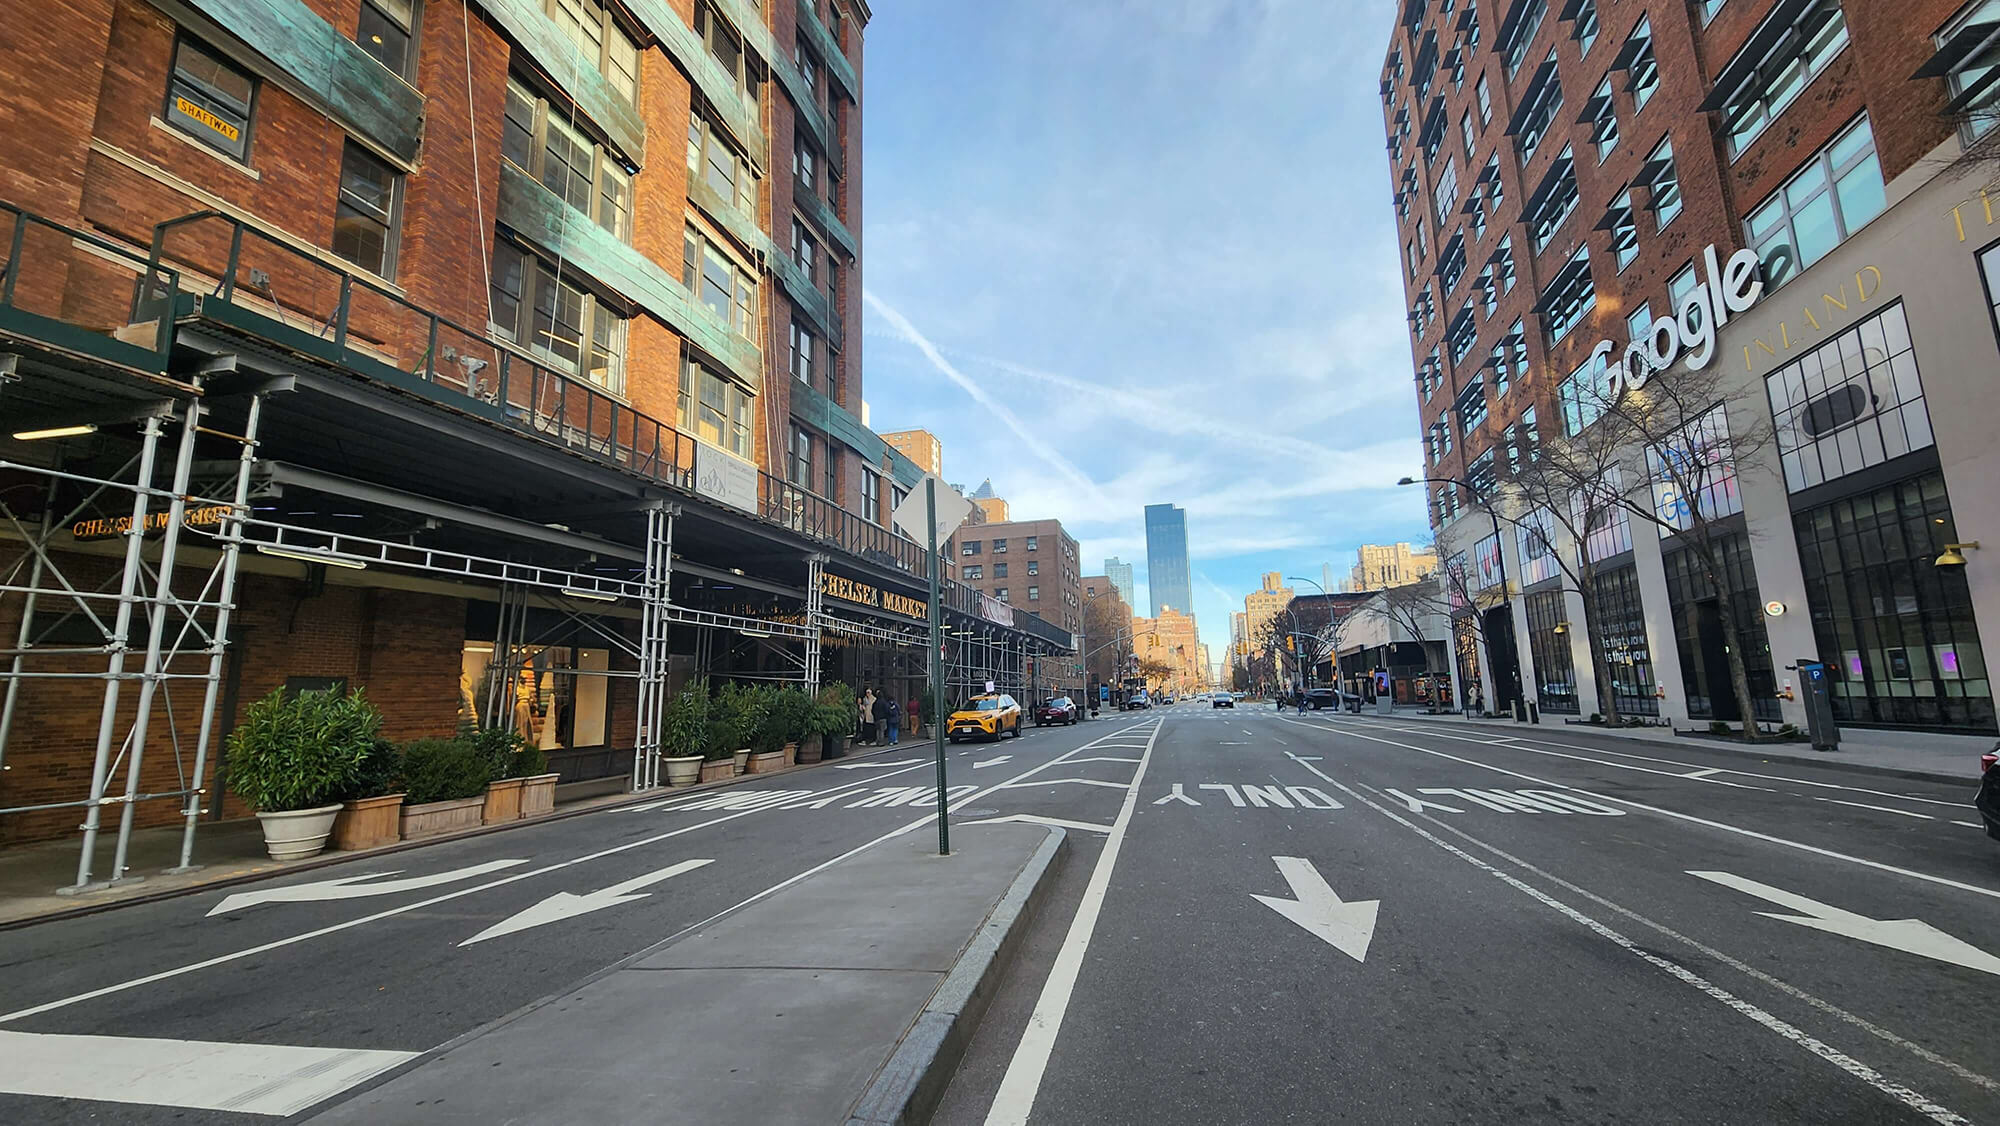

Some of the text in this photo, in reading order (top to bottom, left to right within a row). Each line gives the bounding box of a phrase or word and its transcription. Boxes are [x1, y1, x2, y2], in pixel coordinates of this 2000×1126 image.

[180, 101, 236, 138] SHAFTWAY
[1589, 243, 1765, 402] Google
[1743, 265, 1882, 371] INLAND
[815, 571, 928, 620] CHELSEA MARKET
[777, 785, 979, 809] ONLY
[1152, 783, 1345, 809] ONLY
[1384, 788, 1627, 816] ONLY
